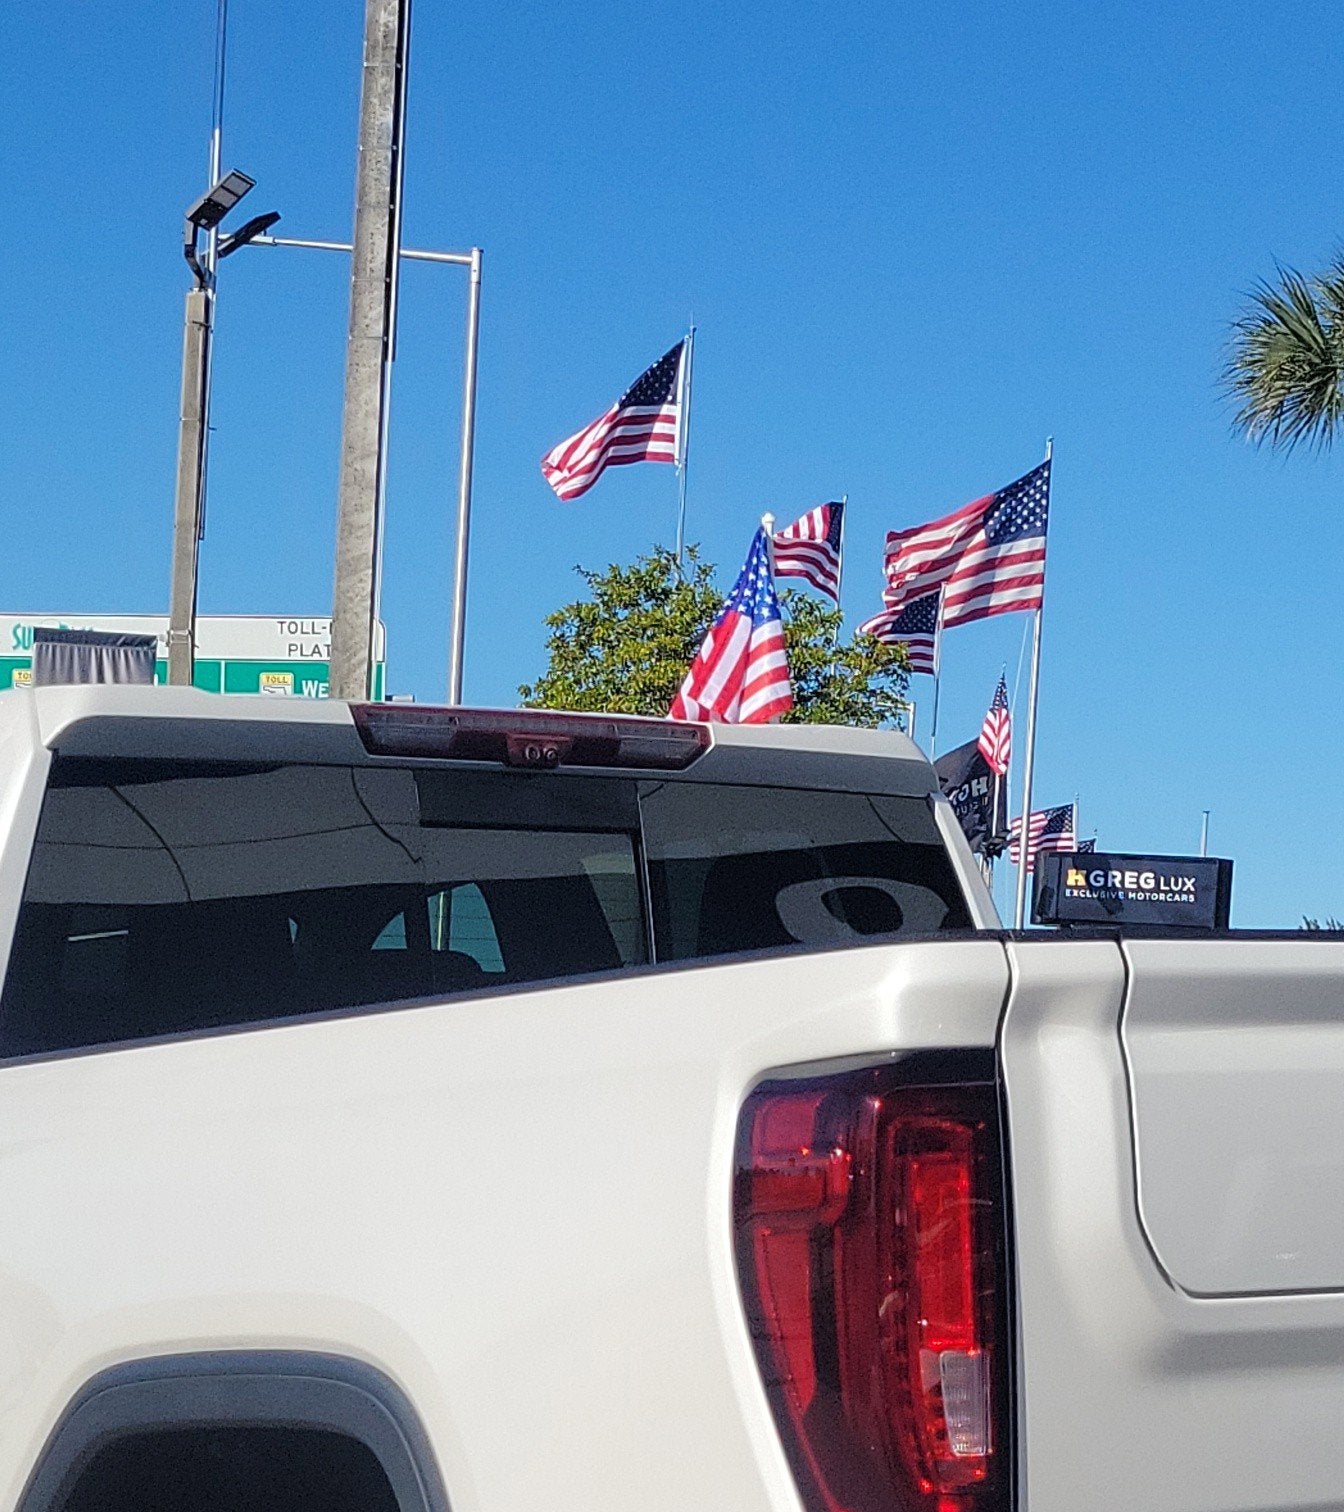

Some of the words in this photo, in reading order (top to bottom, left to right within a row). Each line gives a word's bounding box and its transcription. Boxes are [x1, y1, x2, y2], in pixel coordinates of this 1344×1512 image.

[277, 621, 333, 635] TOLL-
[288, 644, 332, 657] PLAT
[266, 676, 288, 684] TOLL
[1160, 877, 1196, 891] LUX
[1065, 889, 1125, 899] EXCLUSIVE
[1128, 892, 1195, 902] MOTORCARS
